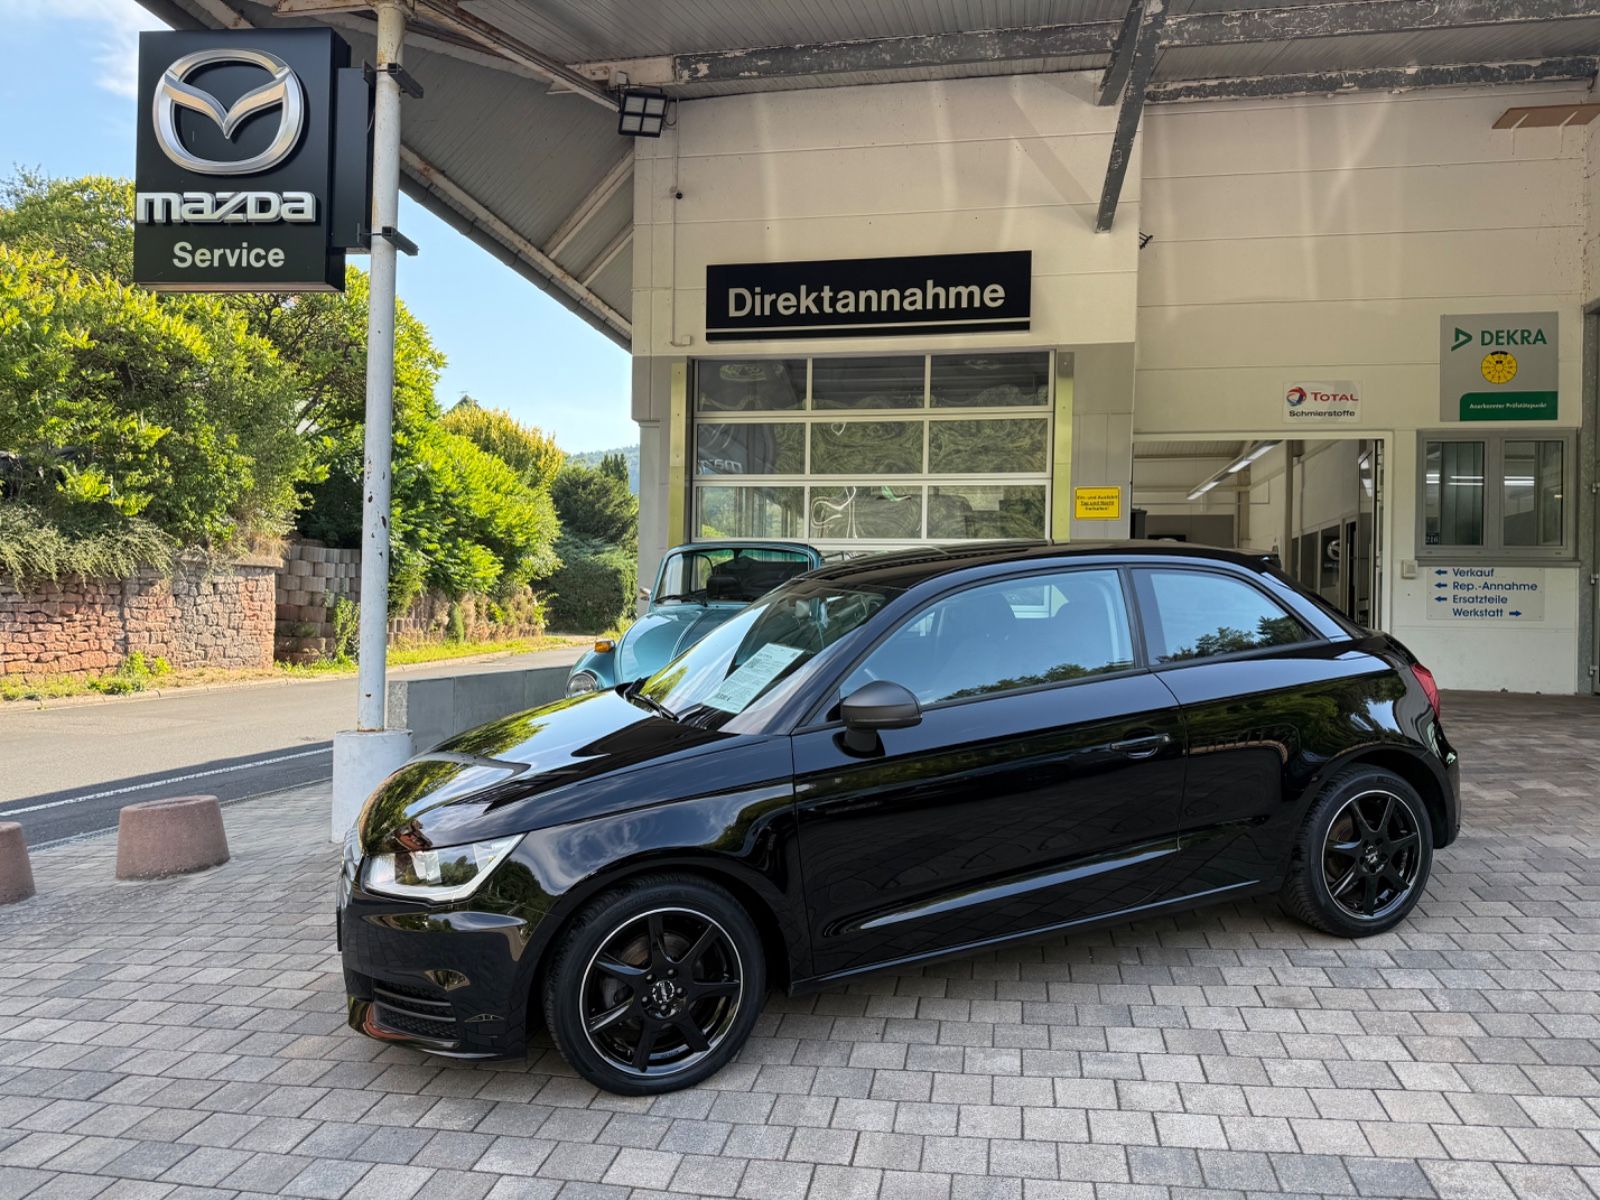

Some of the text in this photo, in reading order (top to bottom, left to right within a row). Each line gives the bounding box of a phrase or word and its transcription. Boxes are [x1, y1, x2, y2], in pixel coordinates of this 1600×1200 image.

[172, 241, 286, 268] Service
[728, 279, 1006, 317] Direktannahme
[1480, 328, 1548, 346] DEKRA
[1311, 391, 1359, 402] TOTAL
[1289, 409, 1356, 417] Schmierstoffe
[1452, 568, 1494, 578] Verkauf
[1452, 581, 1538, 592] Rep.-Annahme
[1452, 594, 1508, 604] Ersatzteile
[1452, 607, 1503, 617] Werkstatt
